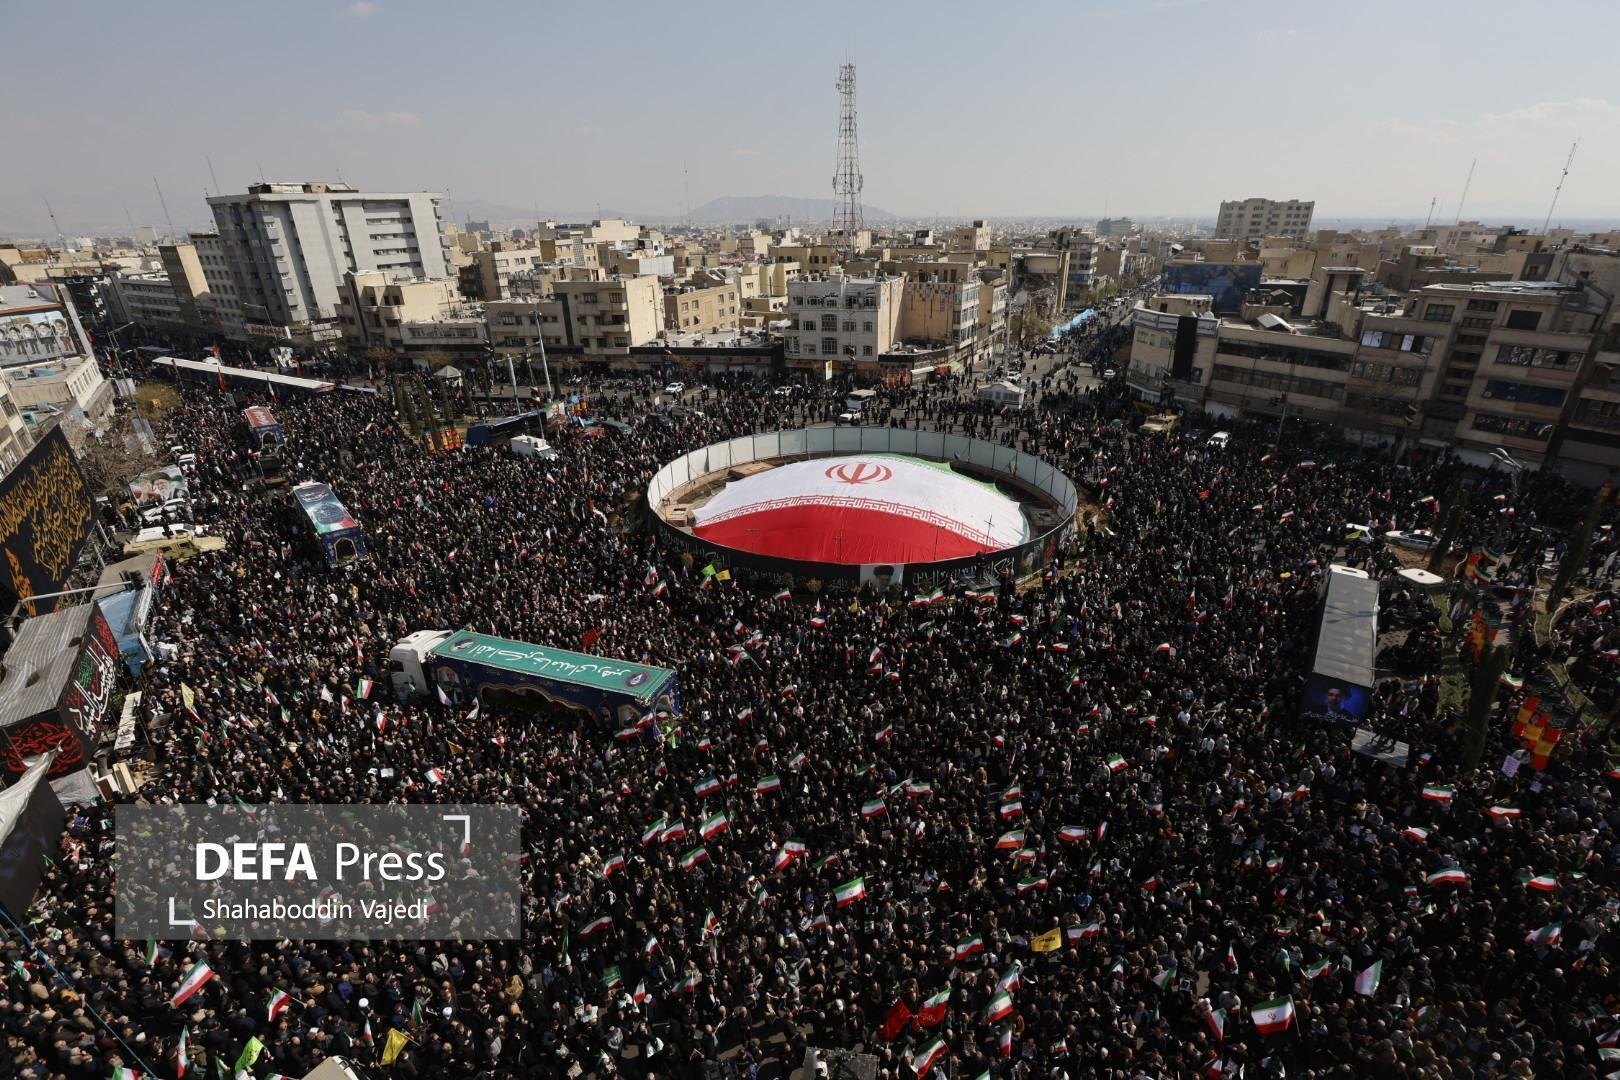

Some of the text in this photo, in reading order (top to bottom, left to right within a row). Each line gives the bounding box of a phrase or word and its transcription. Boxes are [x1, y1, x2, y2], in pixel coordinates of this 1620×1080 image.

[468, 644, 496, 656] الله
[487, 648, 544, 661] اکبر
[598, 665, 631, 677] رهبر
